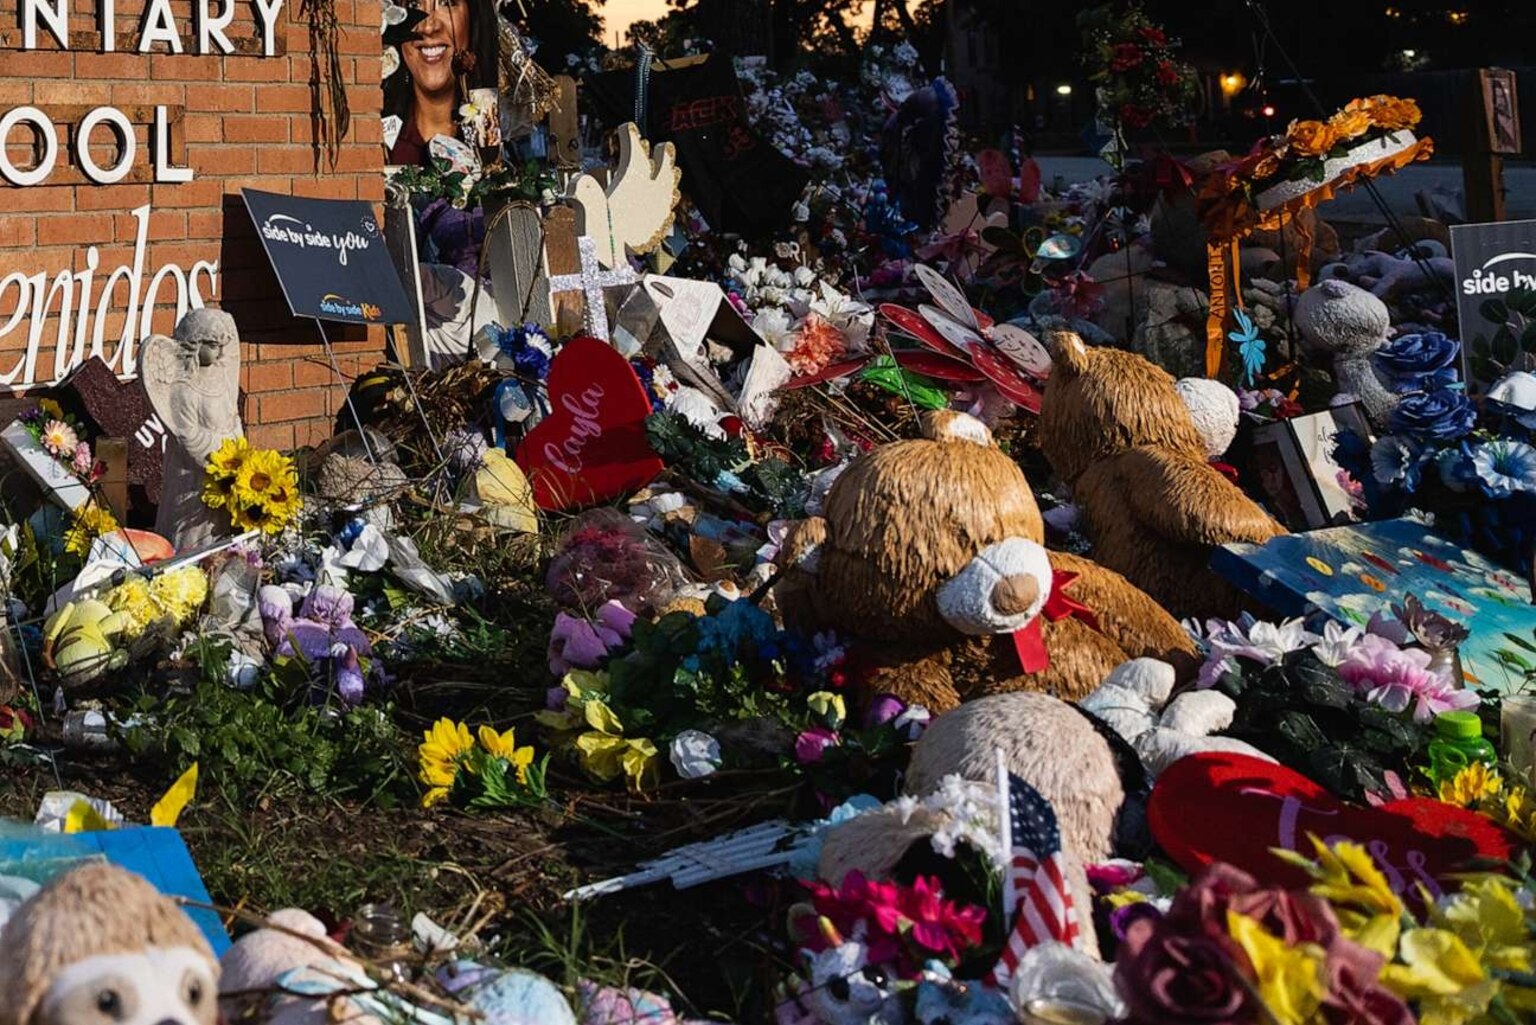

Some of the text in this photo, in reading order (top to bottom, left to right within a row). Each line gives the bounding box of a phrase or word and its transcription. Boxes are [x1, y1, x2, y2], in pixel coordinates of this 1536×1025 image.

[262, 220, 370, 266] side by side you
[1209, 246, 1226, 320] ANTONI
[1462, 268, 1510, 295] side
